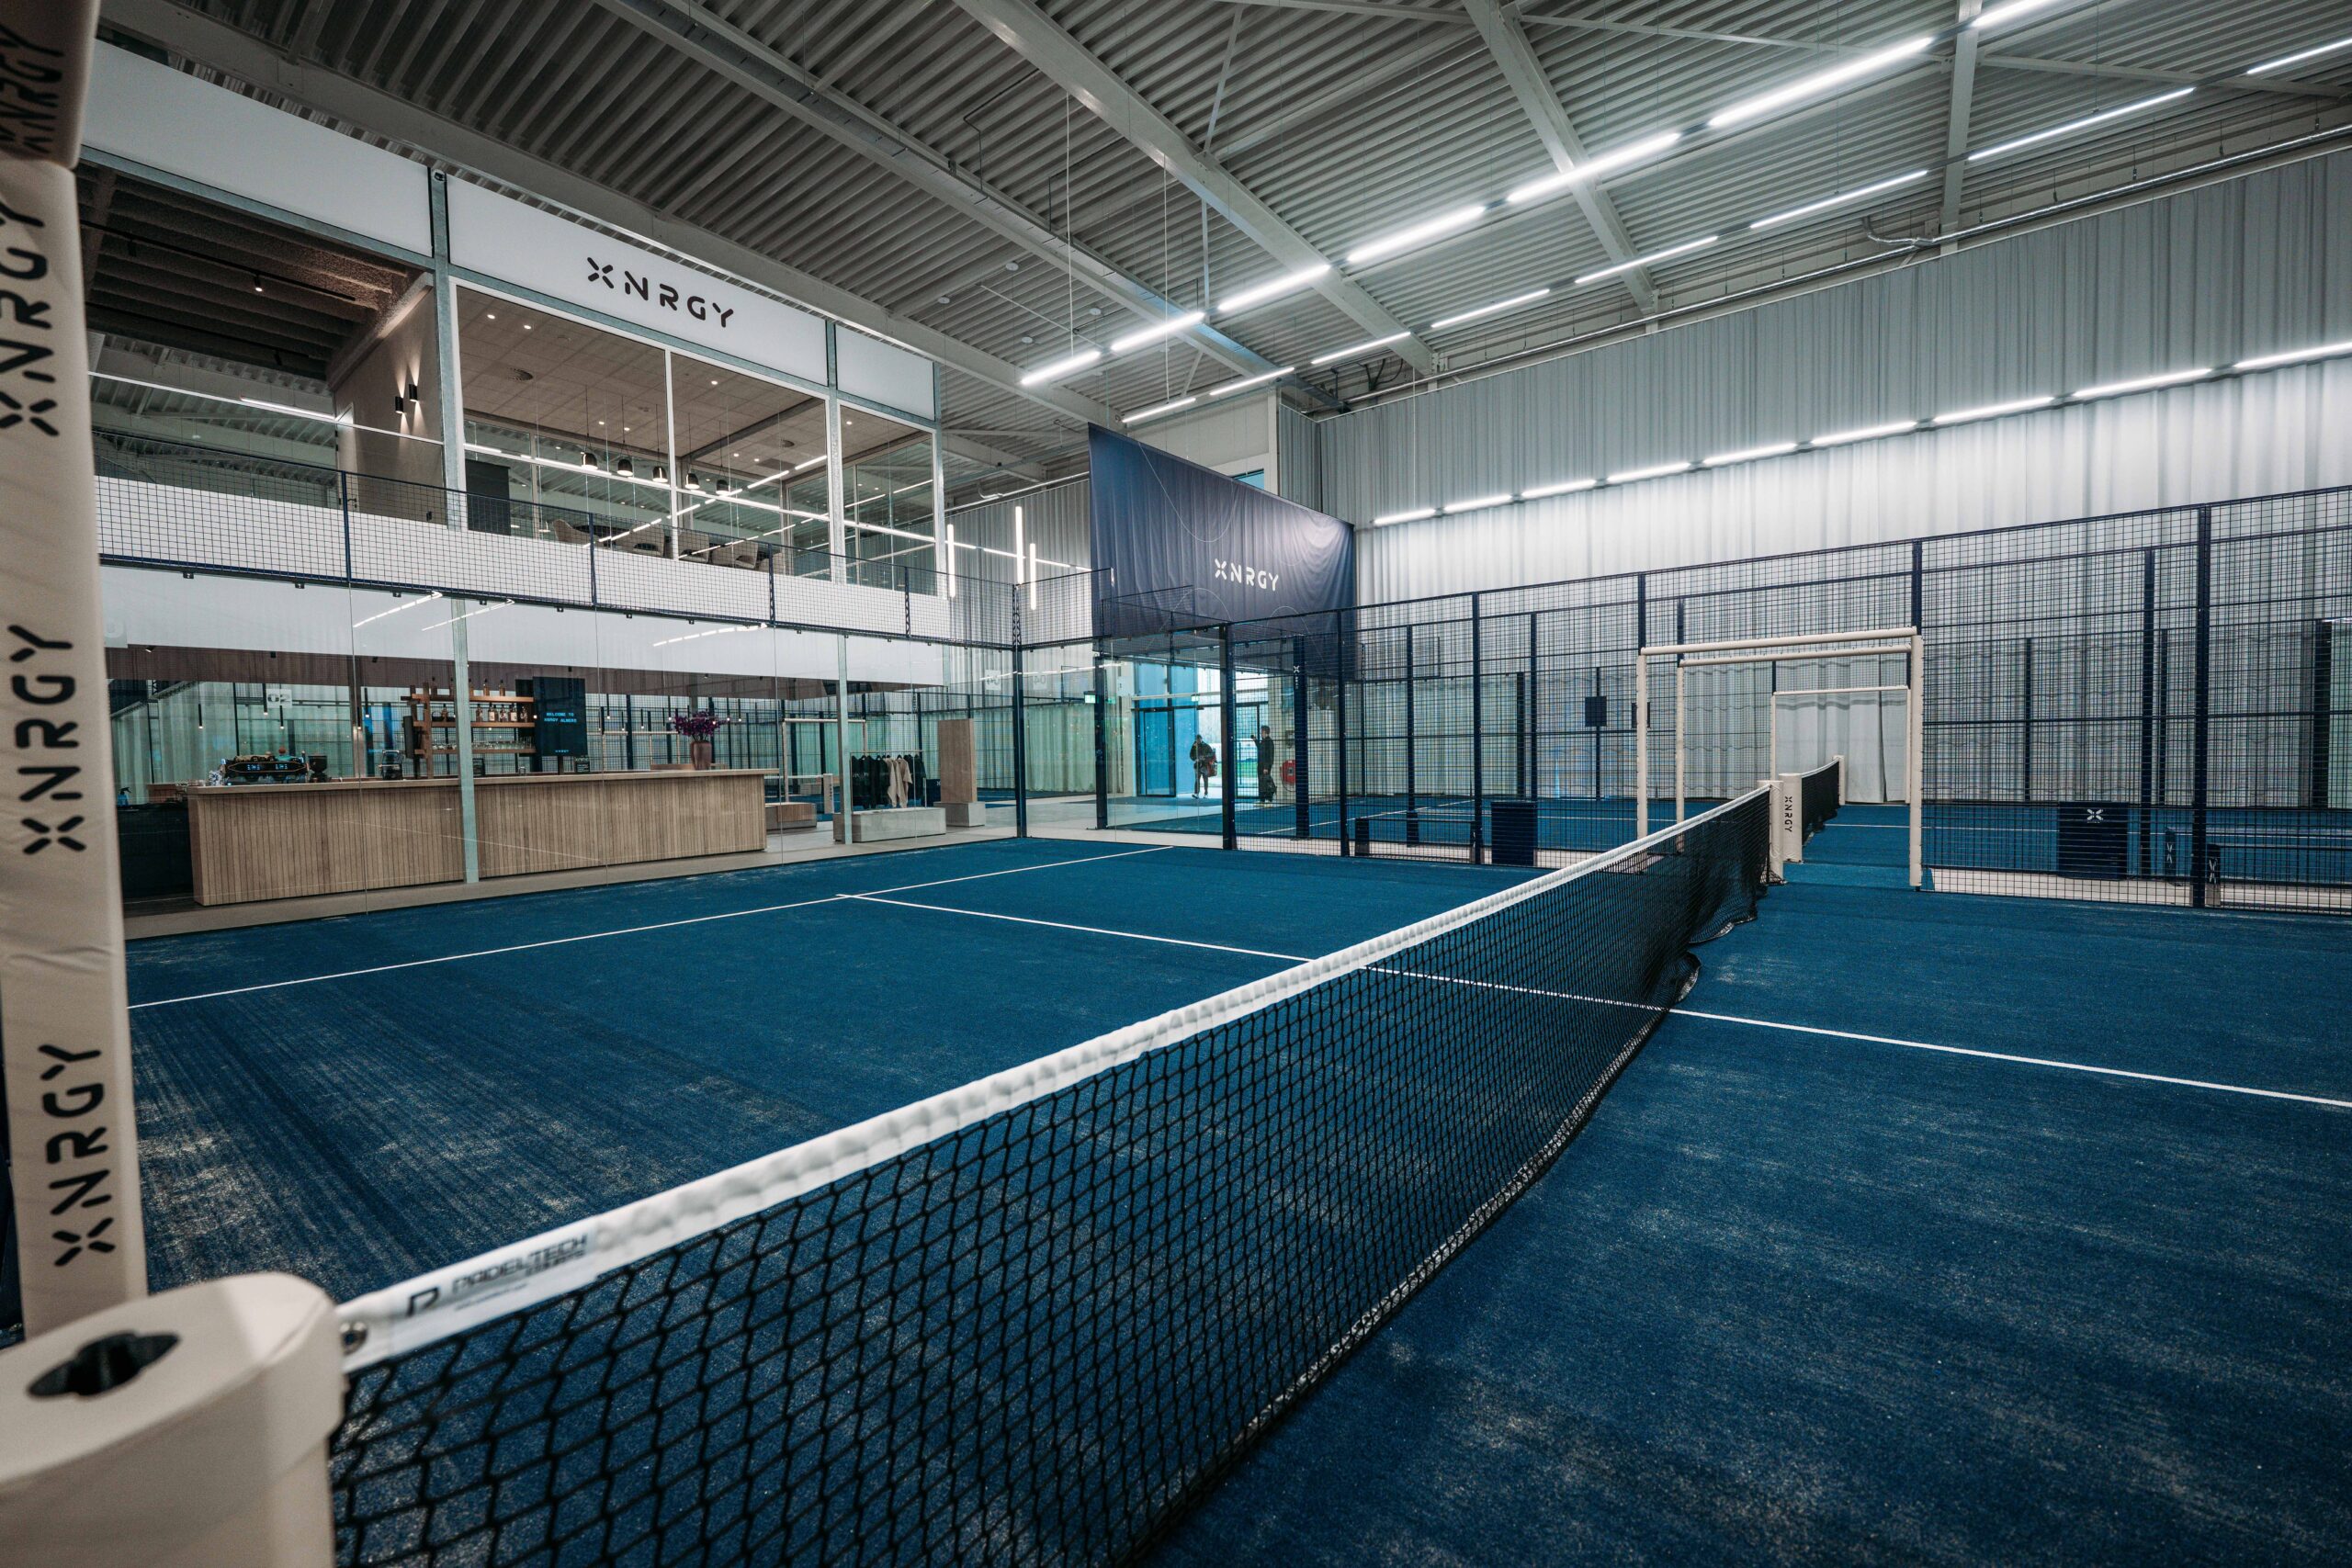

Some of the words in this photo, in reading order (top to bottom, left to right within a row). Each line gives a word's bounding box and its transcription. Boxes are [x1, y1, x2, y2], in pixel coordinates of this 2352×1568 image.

[586, 256, 734, 328] XNRGY
[1214, 558, 1279, 592] XNRGY
[7, 624, 87, 855] XNRGY
[1784, 795, 1793, 833] XNRGY
[38, 1044, 117, 1267] XNRGY
